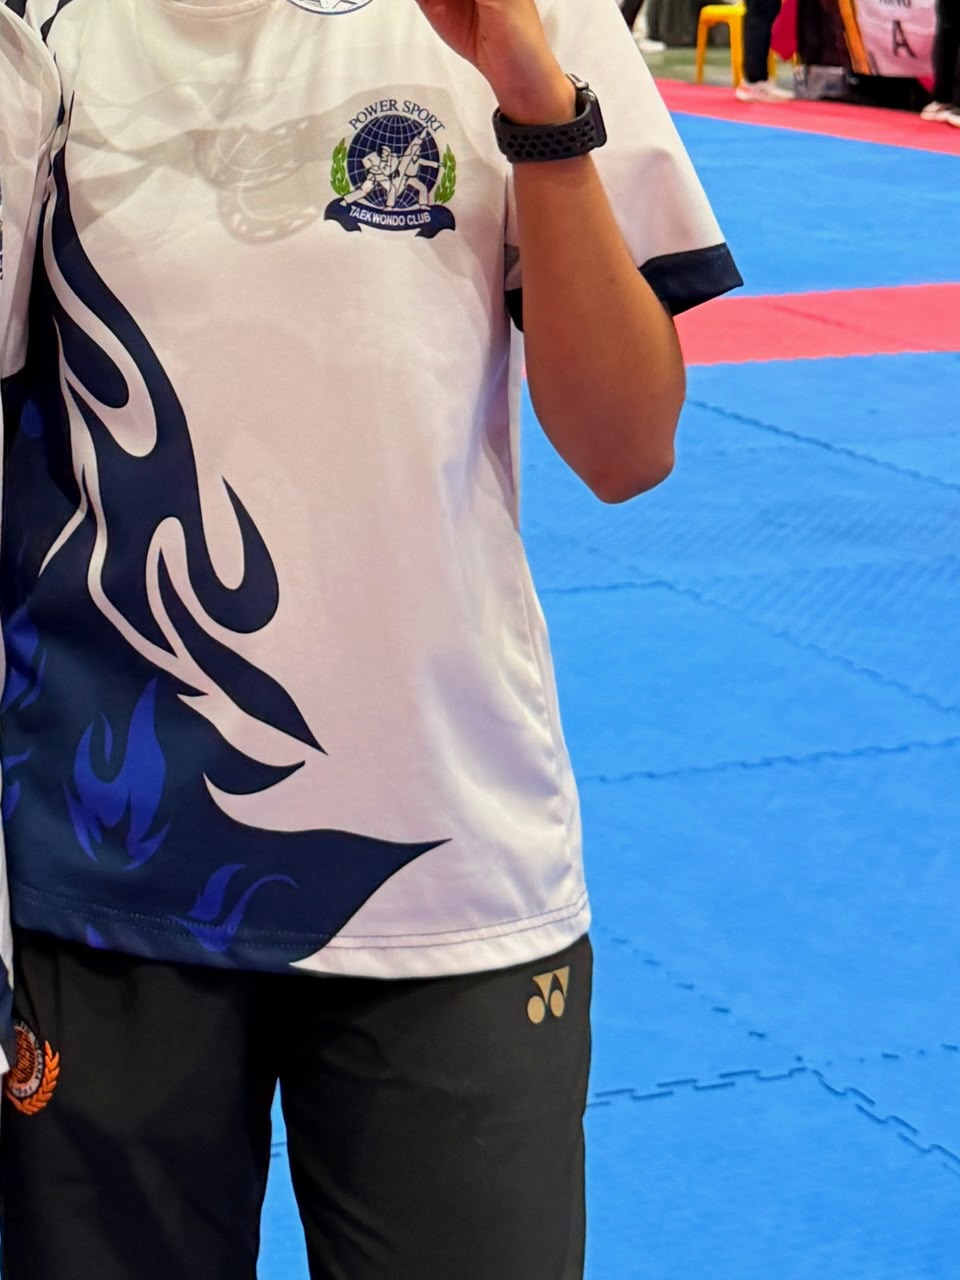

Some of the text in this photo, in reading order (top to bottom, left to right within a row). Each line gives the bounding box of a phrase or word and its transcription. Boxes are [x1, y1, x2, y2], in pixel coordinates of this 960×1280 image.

[892, 18, 917, 59] A
[348, 98, 446, 134] POWER SPORT
[348, 205, 432, 226] TAEKWONDO CLUB
